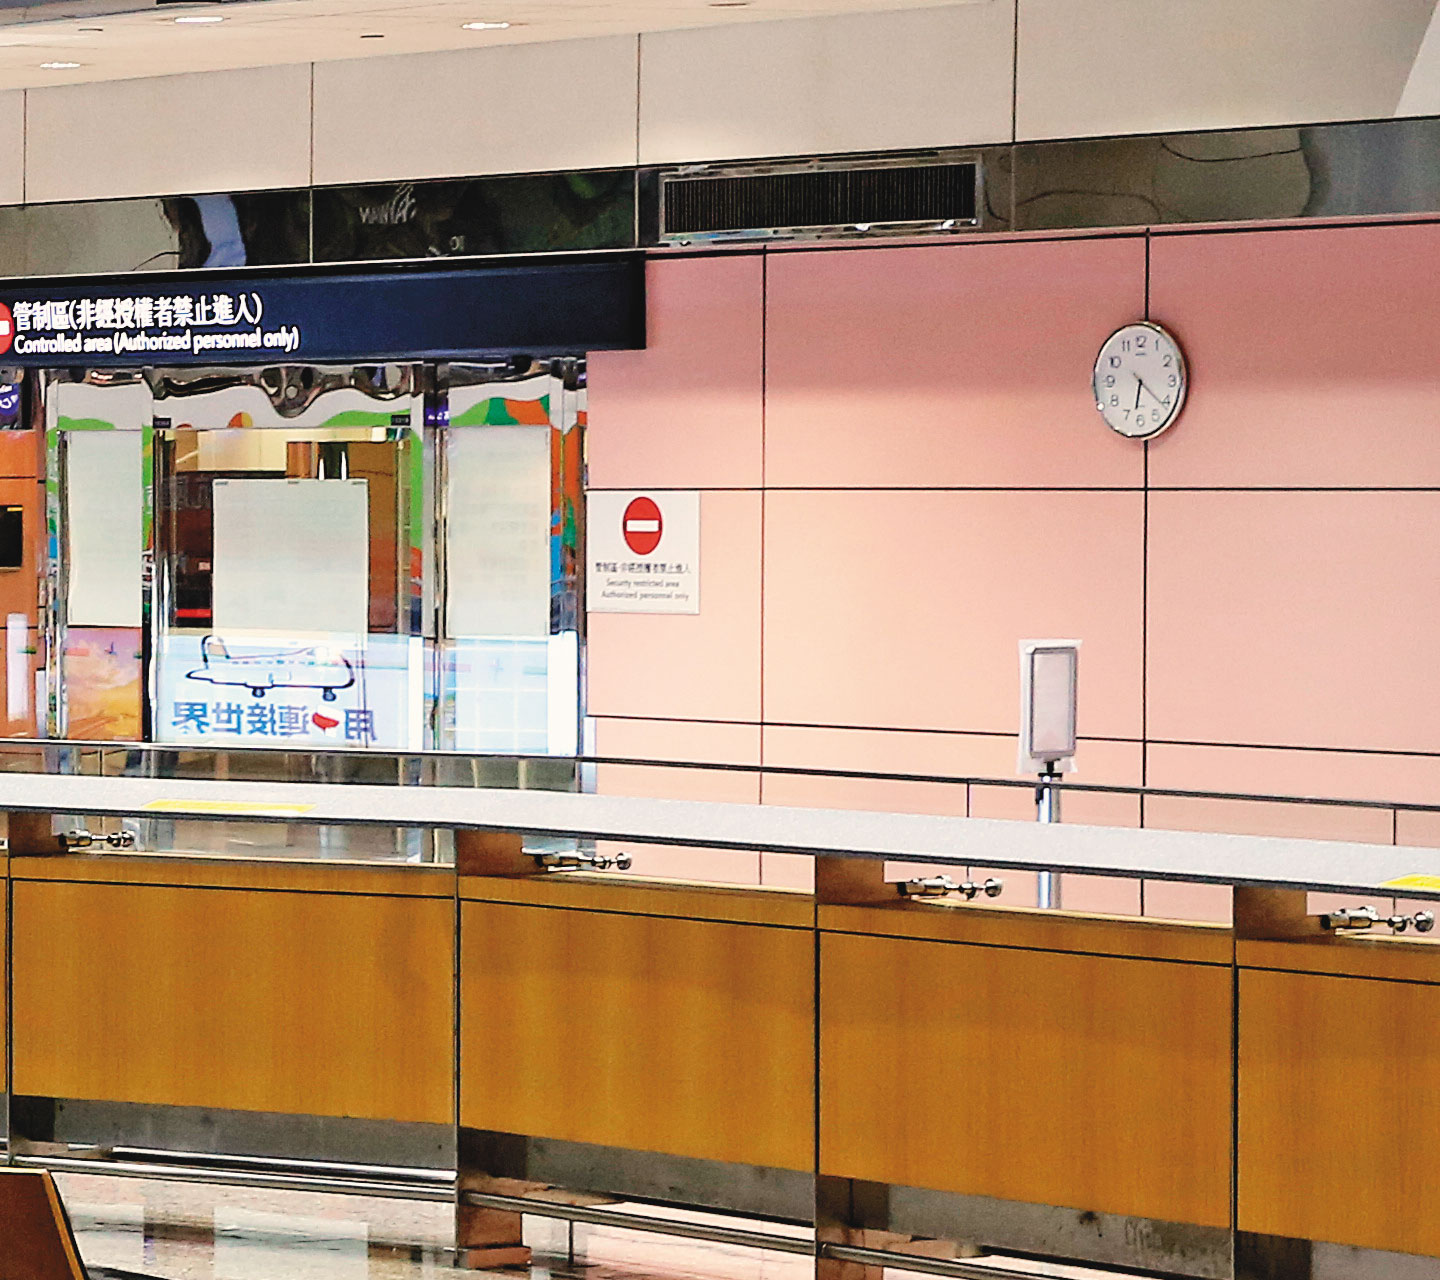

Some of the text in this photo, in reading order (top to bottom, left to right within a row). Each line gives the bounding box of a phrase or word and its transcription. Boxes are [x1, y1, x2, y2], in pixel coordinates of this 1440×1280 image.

[13, 293, 263, 331] 管制區(非經授權者禁止進入)
[13, 326, 299, 354] Controlled area (Authorized personnel only)
[1163, 355, 1172, 367] 2
[1107, 375, 1115, 387] 9
[1168, 375, 1176, 387] 3
